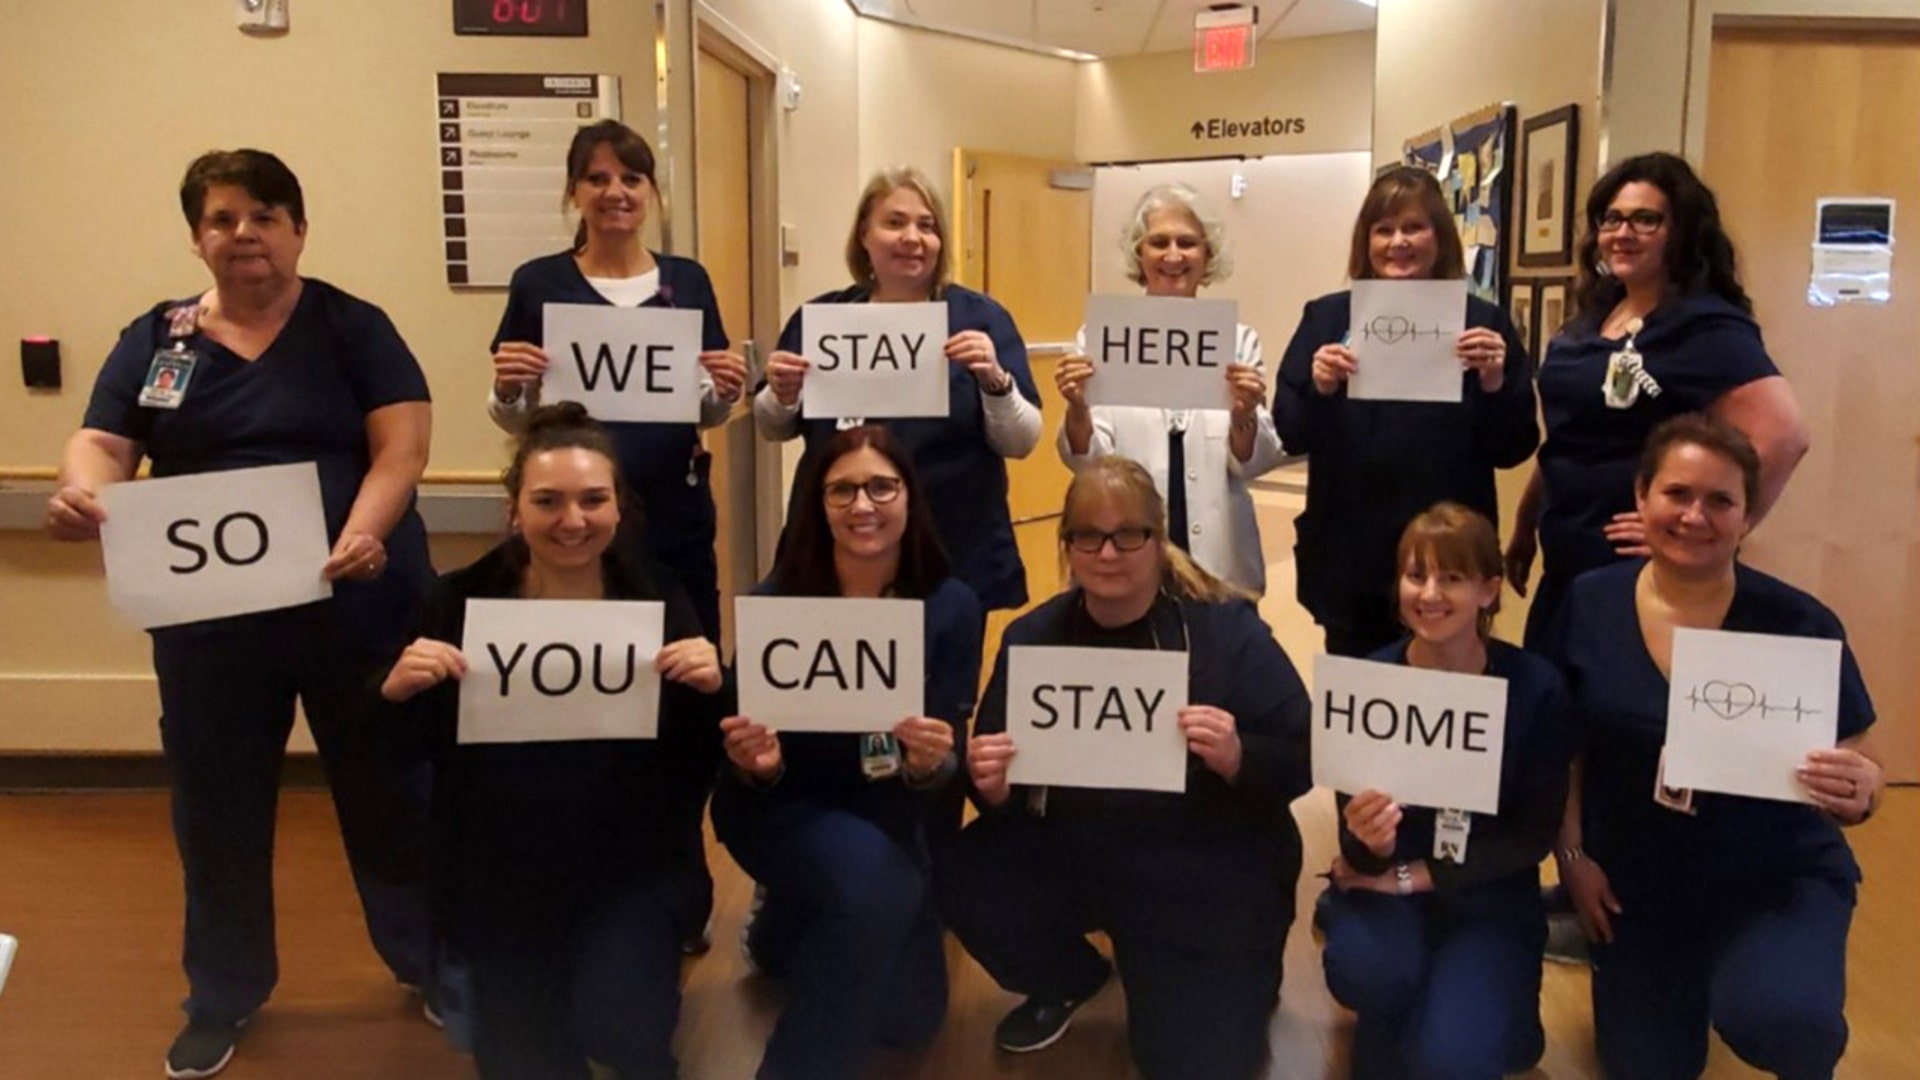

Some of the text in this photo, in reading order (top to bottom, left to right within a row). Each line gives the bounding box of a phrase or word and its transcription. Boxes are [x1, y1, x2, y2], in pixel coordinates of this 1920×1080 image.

[1207, 117, 1305, 139] Elevators
[571, 342, 674, 394] WE
[817, 333, 925, 372] STAY
[1102, 326, 1219, 368] HERE
[166, 511, 269, 575] SO
[486, 642, 636, 697] YOU
[761, 638, 897, 691] CAN
[1030, 684, 1165, 734] STAY
[1324, 690, 1489, 753] HOME
